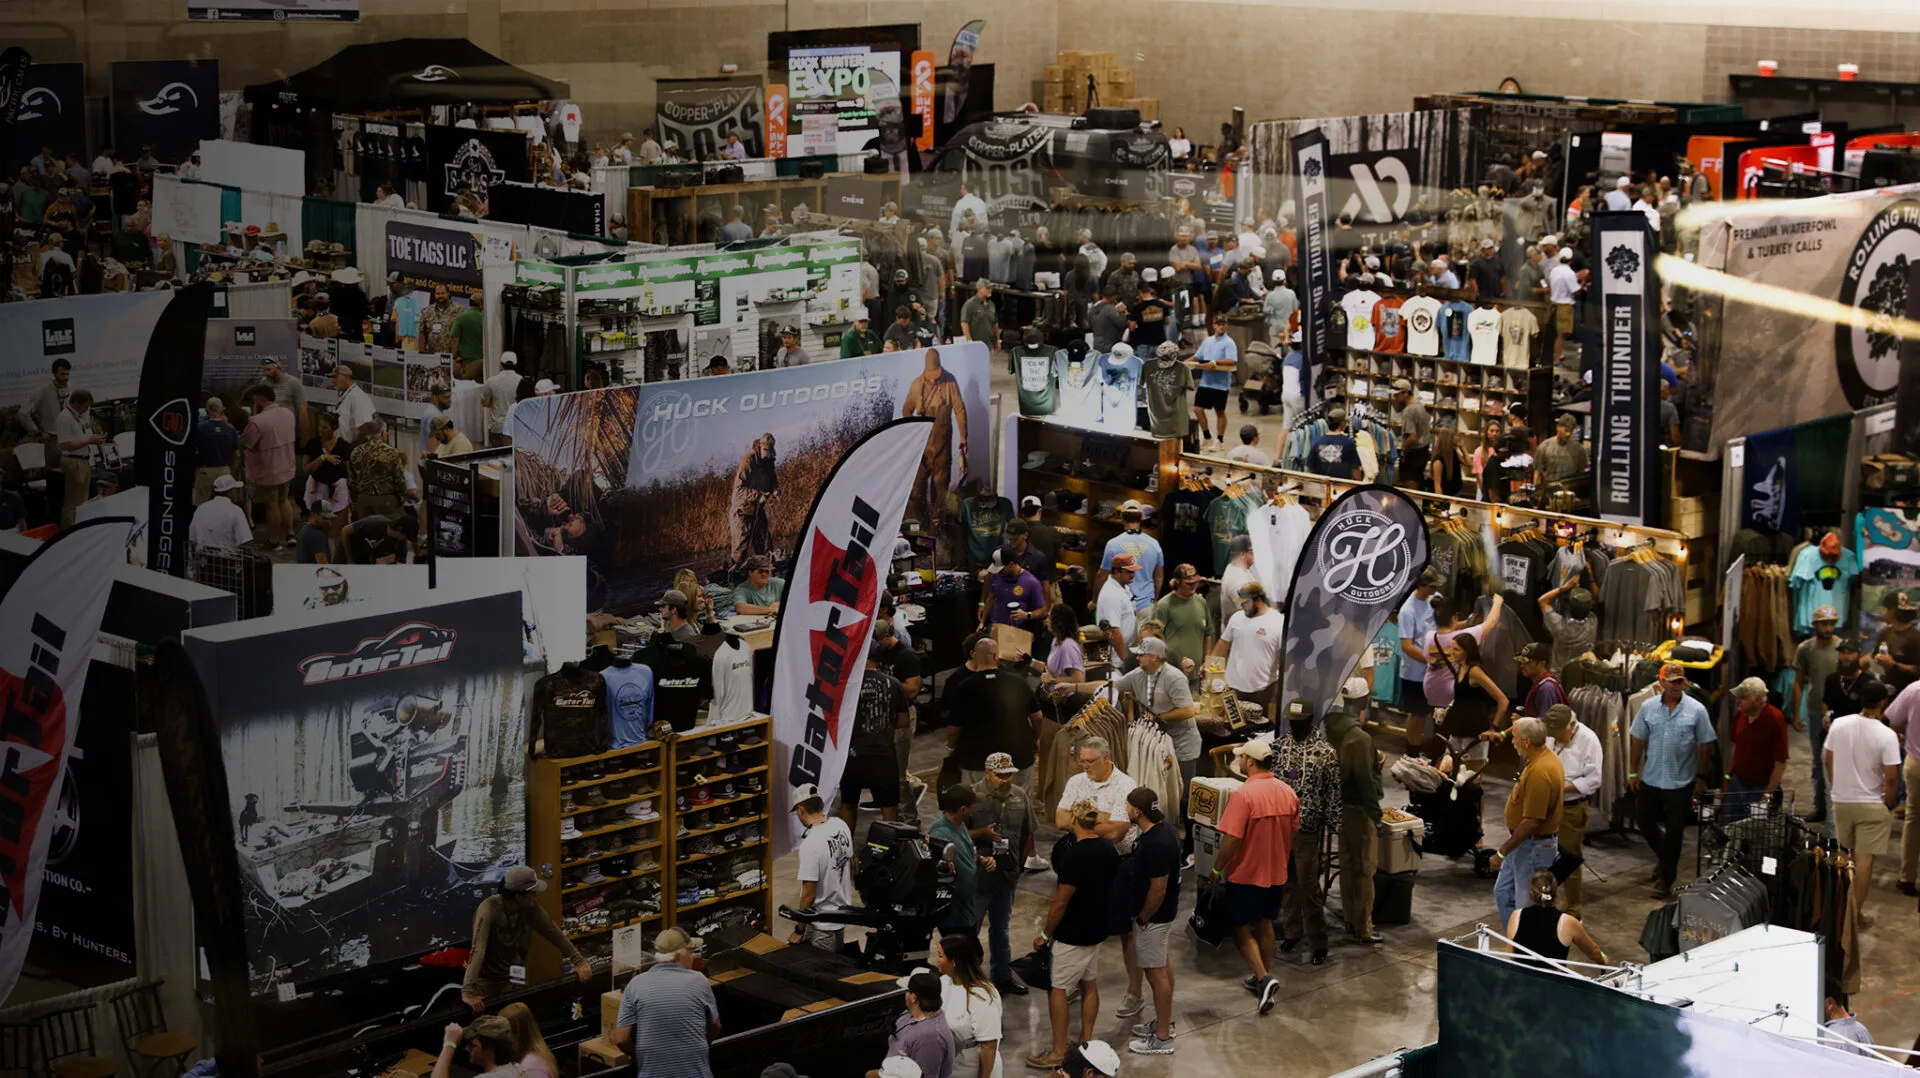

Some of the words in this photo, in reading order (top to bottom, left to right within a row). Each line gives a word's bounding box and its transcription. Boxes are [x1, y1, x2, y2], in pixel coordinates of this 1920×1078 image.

[788, 66, 870, 98] EXPO
[1492, 103, 1577, 119] REALTREE
[1733, 225, 1777, 241] PREMIUM
[1781, 218, 1838, 236] WATERFOWL
[1848, 208, 1900, 282] ROLLING
[388, 234, 412, 261] TOE
[411, 240, 445, 266] TAGS
[446, 244, 467, 270] LLC
[1747, 249, 1755, 260] &
[1757, 242, 1793, 258] TURKEY
[1795, 239, 1823, 253] CALLS
[1610, 305, 1632, 406] THUNDER
[652, 396, 731, 422] HUCK
[738, 376, 884, 413] OUTDOORS
[1610, 414, 1632, 504] ROLLING
[1337, 515, 1373, 531] HUCK
[1350, 579, 1396, 598] OUTDOORS
[304, 640, 454, 684] GatorTail
[72, 931, 132, 965] HUNTERS.
